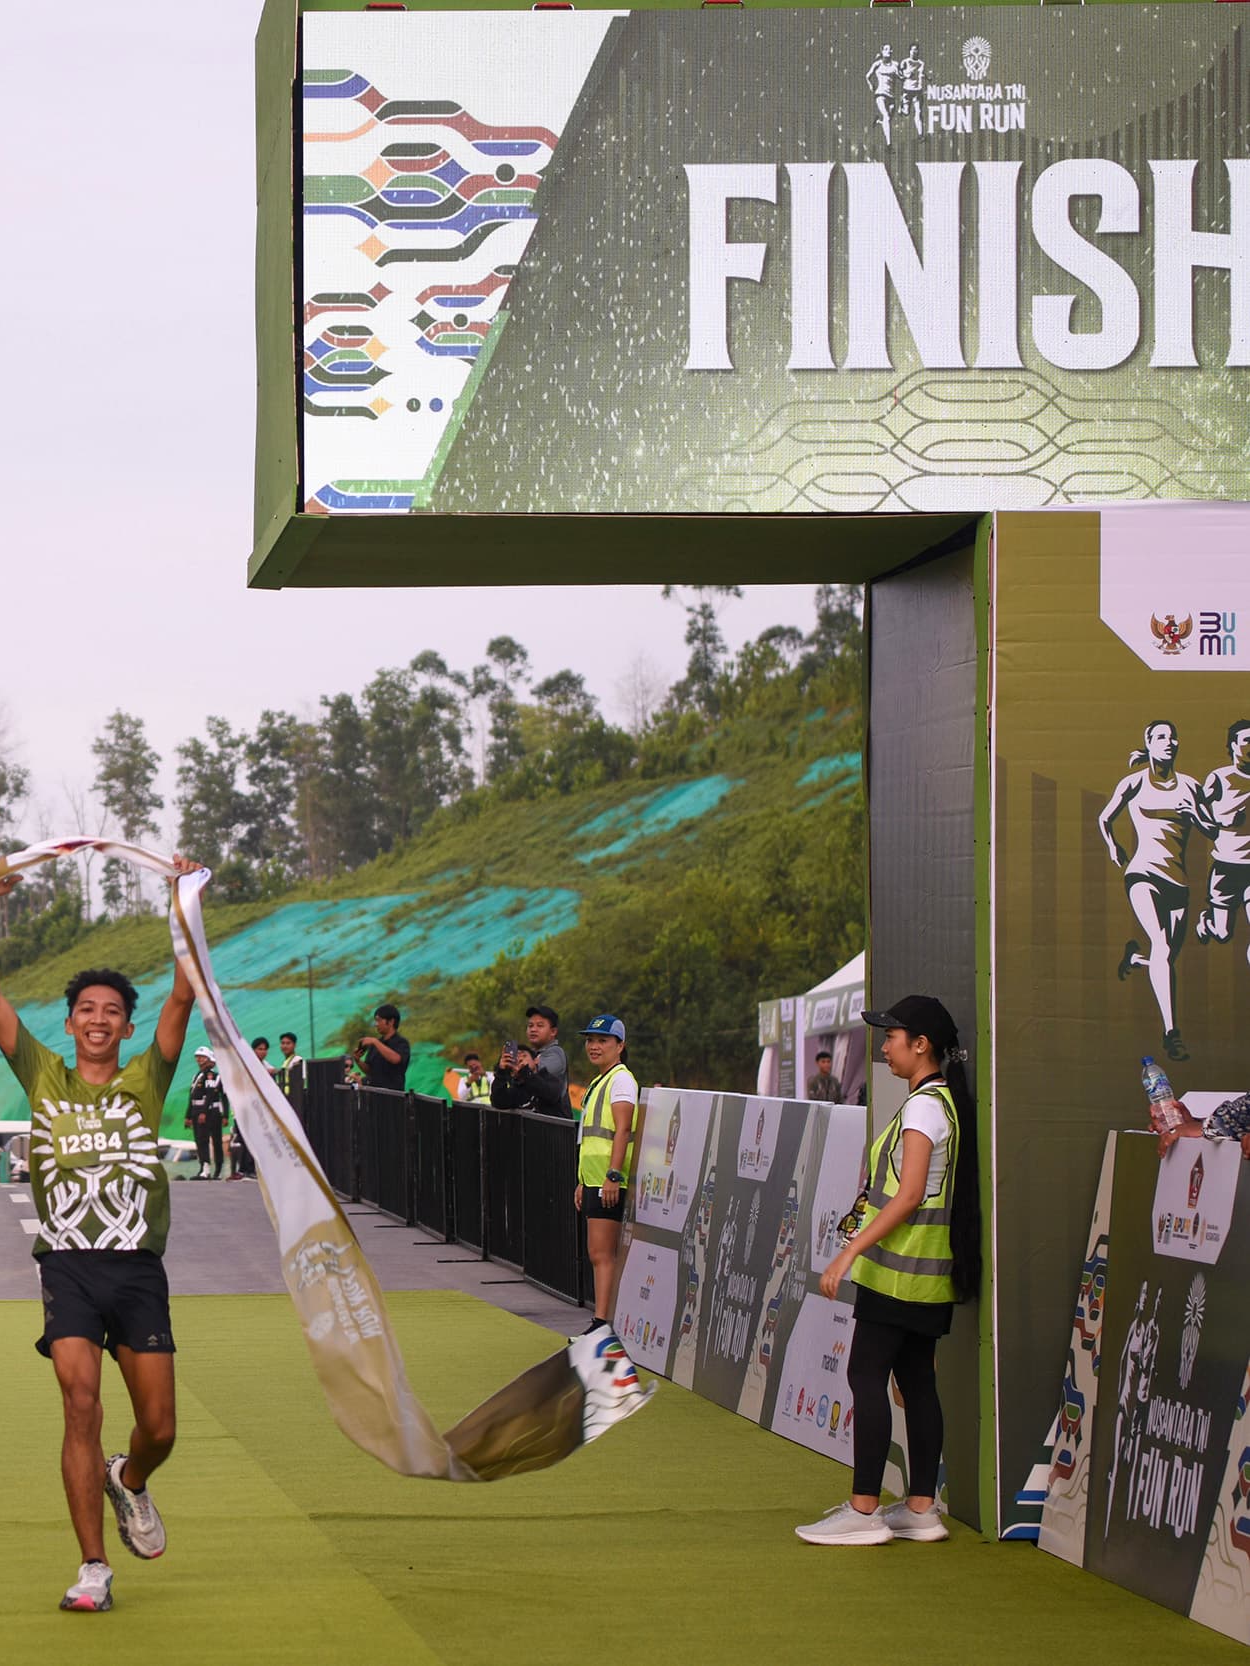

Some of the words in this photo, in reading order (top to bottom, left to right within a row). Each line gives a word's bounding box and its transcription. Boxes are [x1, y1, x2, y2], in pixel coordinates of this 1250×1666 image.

[927, 83, 1002, 101] NUSANTARA
[1005, 83, 1026, 100] TNI
[927, 104, 972, 133] FUN
[980, 103, 1026, 133] RUN
[683, 158, 1250, 370] FINISH
[59, 1131, 122, 1155] 12384
[1146, 1395, 1195, 1449] NUSANTARA
[1194, 1408, 1212, 1453] TNI
[1132, 1447, 1169, 1530] FUN
[1165, 1455, 1204, 1539] RUN
